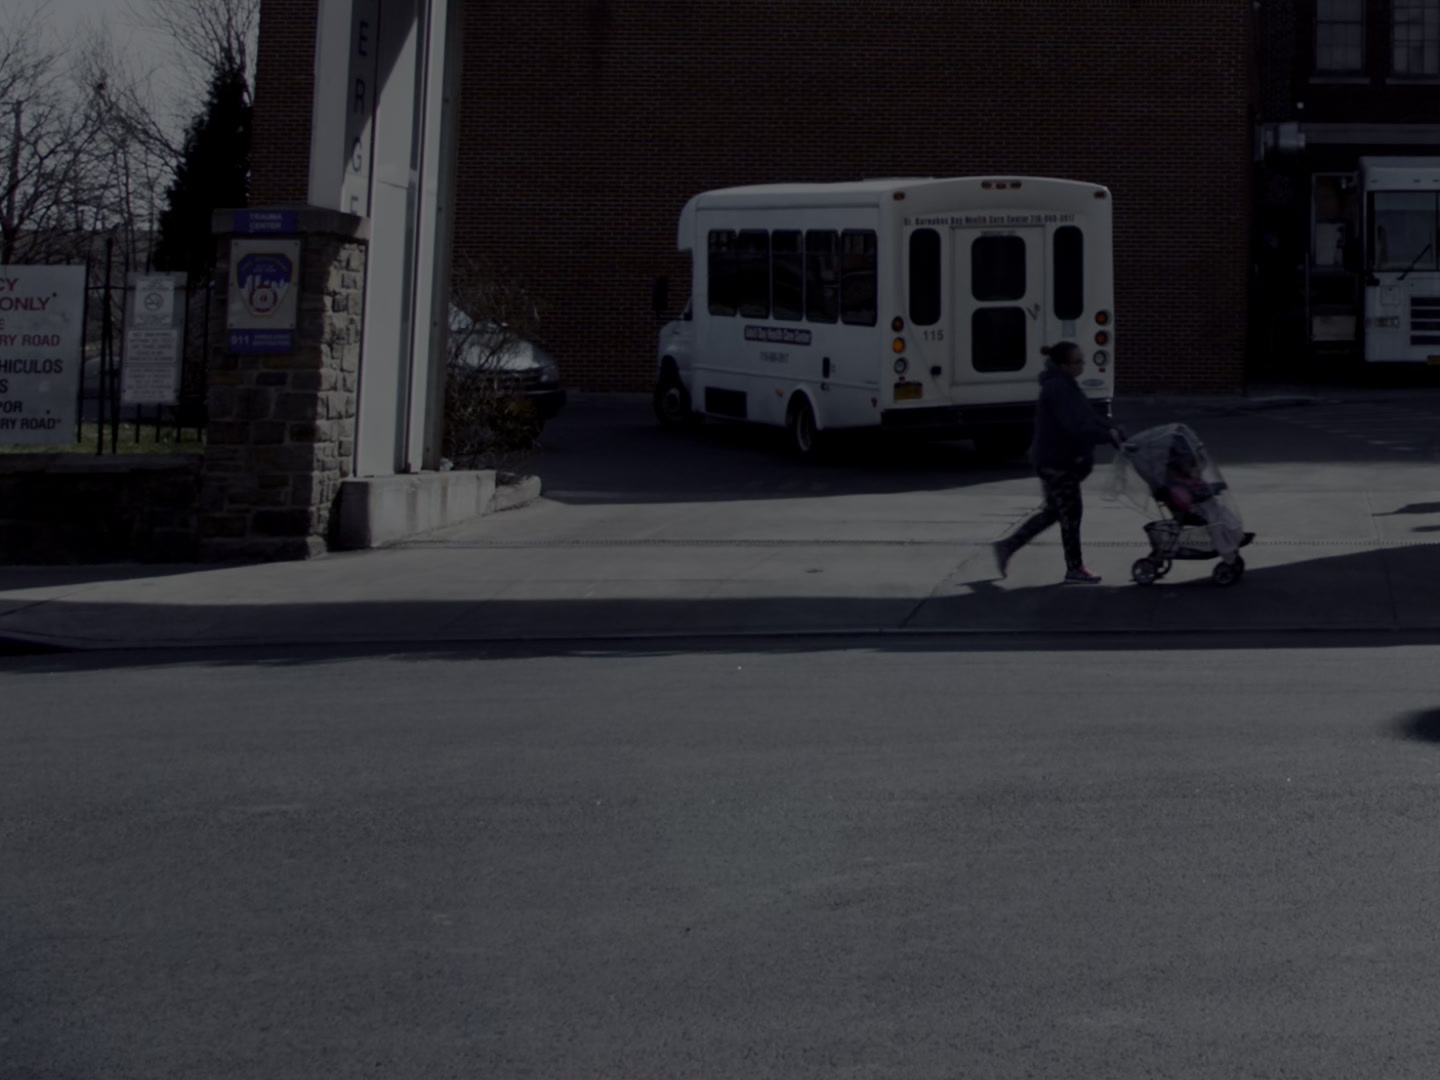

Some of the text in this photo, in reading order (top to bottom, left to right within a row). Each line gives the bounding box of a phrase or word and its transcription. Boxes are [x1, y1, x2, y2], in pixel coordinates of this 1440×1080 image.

[22, 334, 61, 347] ROAD
[231, 335, 250, 345] 911
[923, 330, 944, 341] 115
